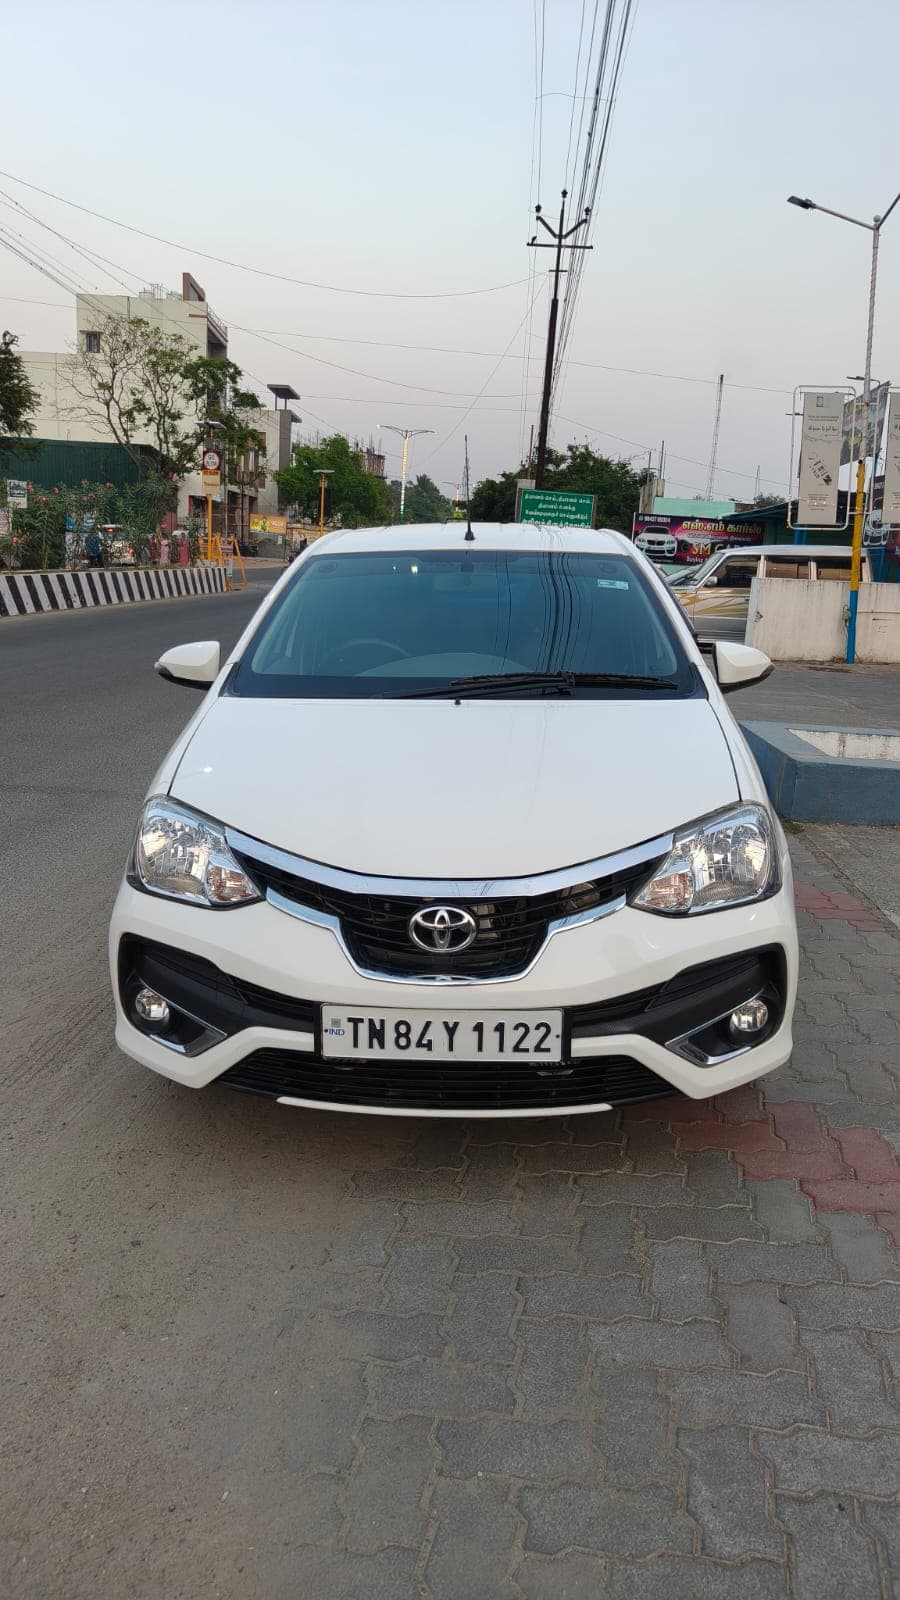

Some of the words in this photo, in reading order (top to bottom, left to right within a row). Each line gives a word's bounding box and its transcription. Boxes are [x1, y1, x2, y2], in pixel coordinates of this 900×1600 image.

[692, 542, 712, 555] SM
[328, 1028, 345, 1036] IND
[347, 1017, 386, 1050] TN
[394, 1020, 433, 1051] 84
[442, 1021, 460, 1052] Y
[472, 1021, 551, 1053] 1122
